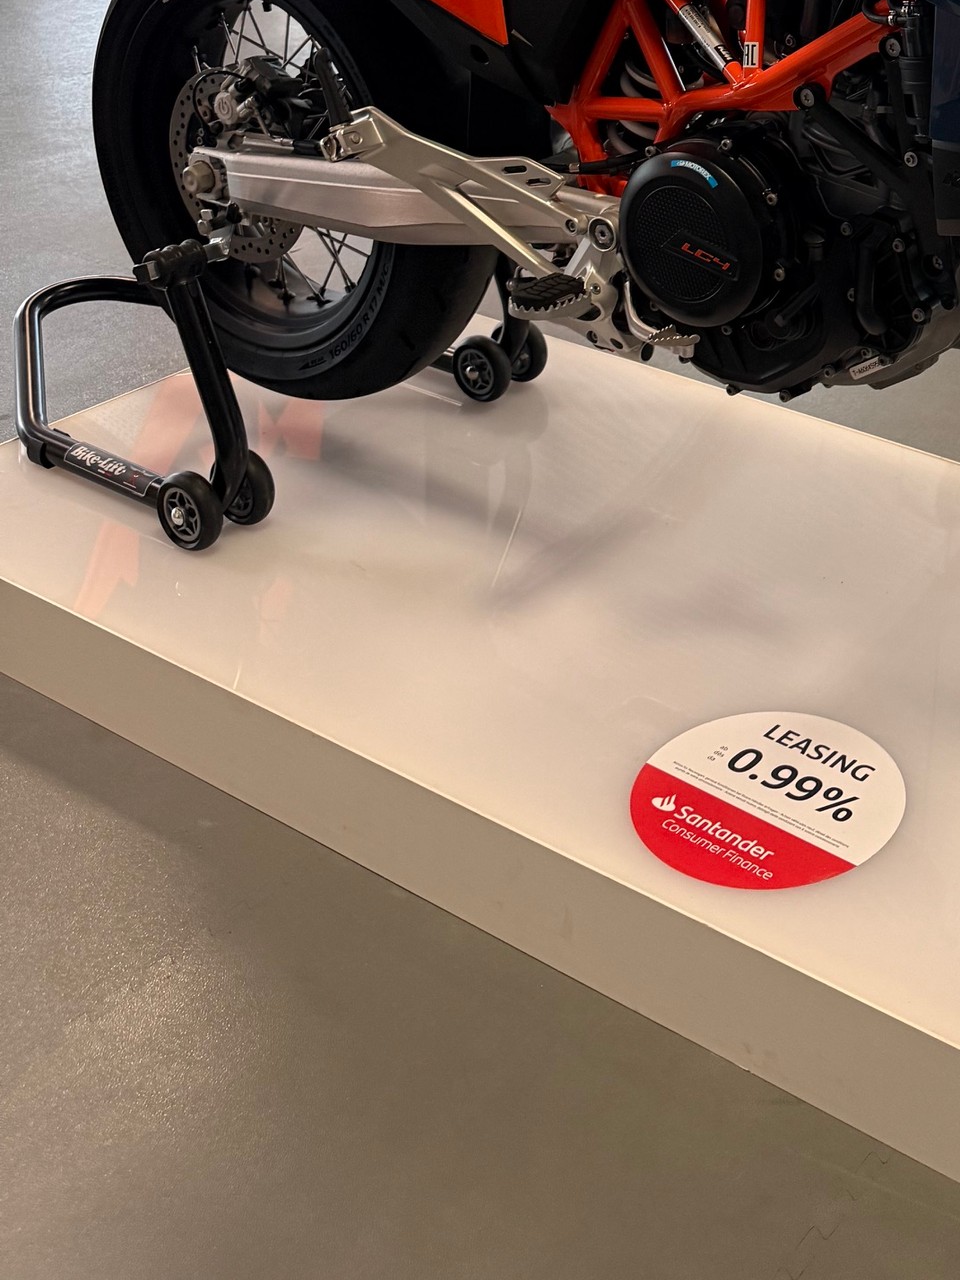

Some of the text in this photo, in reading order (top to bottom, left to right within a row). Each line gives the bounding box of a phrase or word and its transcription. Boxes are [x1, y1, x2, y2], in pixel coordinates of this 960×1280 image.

[683, 160, 712, 181] MOTOREX
[681, 242, 731, 271] LC4
[328, 323, 364, 360] 160/60
[362, 312, 371, 325] R
[369, 296, 379, 314] 17
[70, 445, 127, 476] Bike-Lift
[762, 723, 877, 783] LEASING
[727, 748, 860, 823] 0.99%
[661, 818, 774, 881] Consumer Finance
[673, 804, 775, 862] Santander
